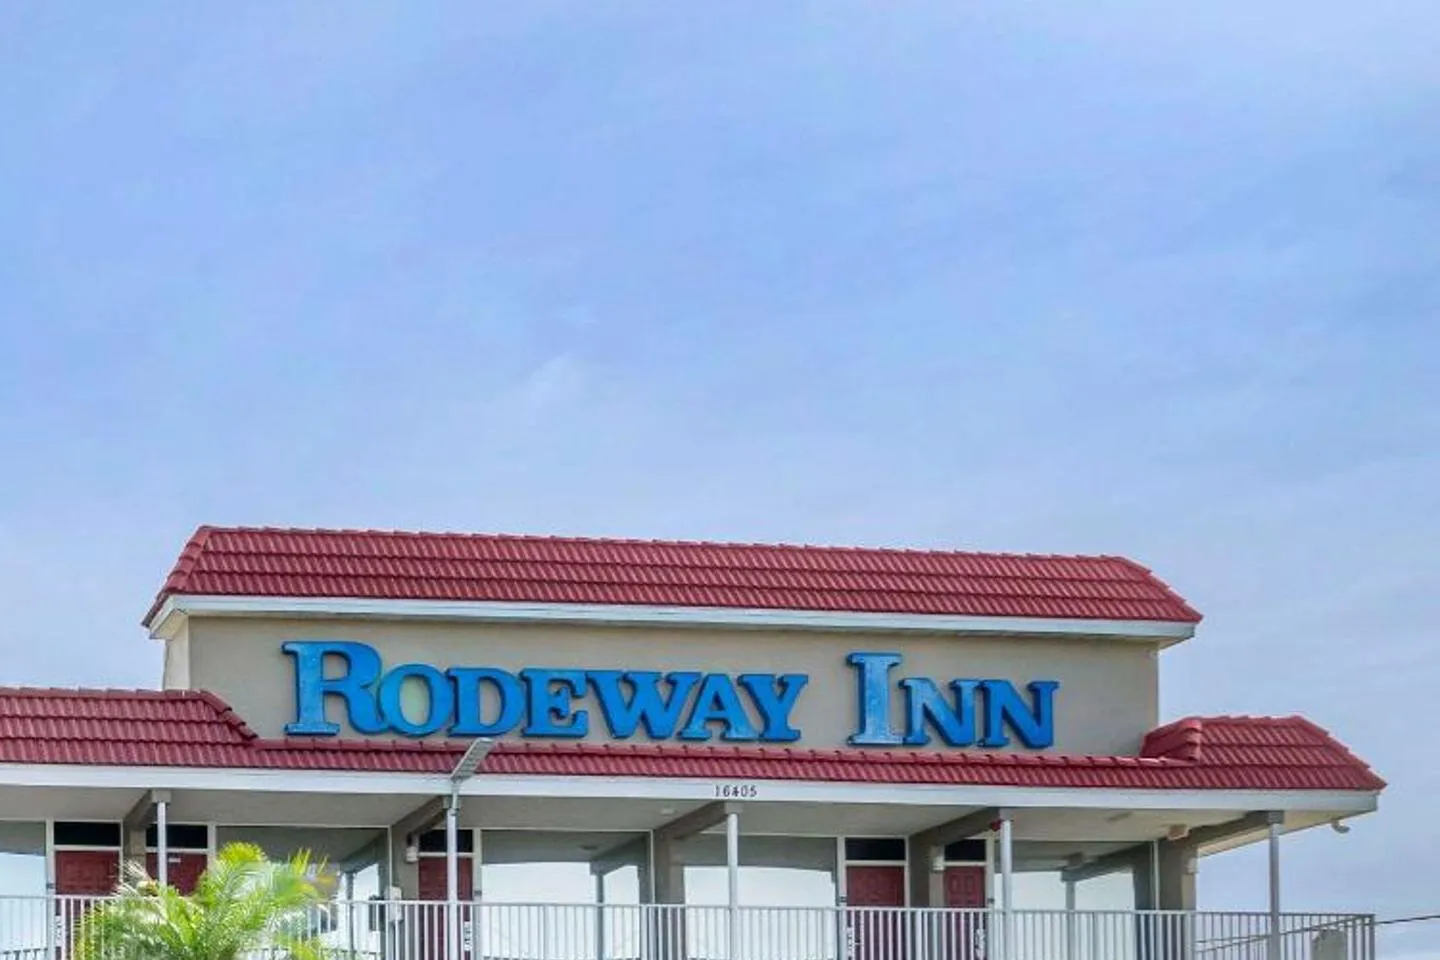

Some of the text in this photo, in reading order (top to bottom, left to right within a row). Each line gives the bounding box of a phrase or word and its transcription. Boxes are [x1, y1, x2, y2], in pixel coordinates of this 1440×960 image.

[282, 641, 1059, 749] RODEWAY INN
[714, 784, 758, 797] 16405
